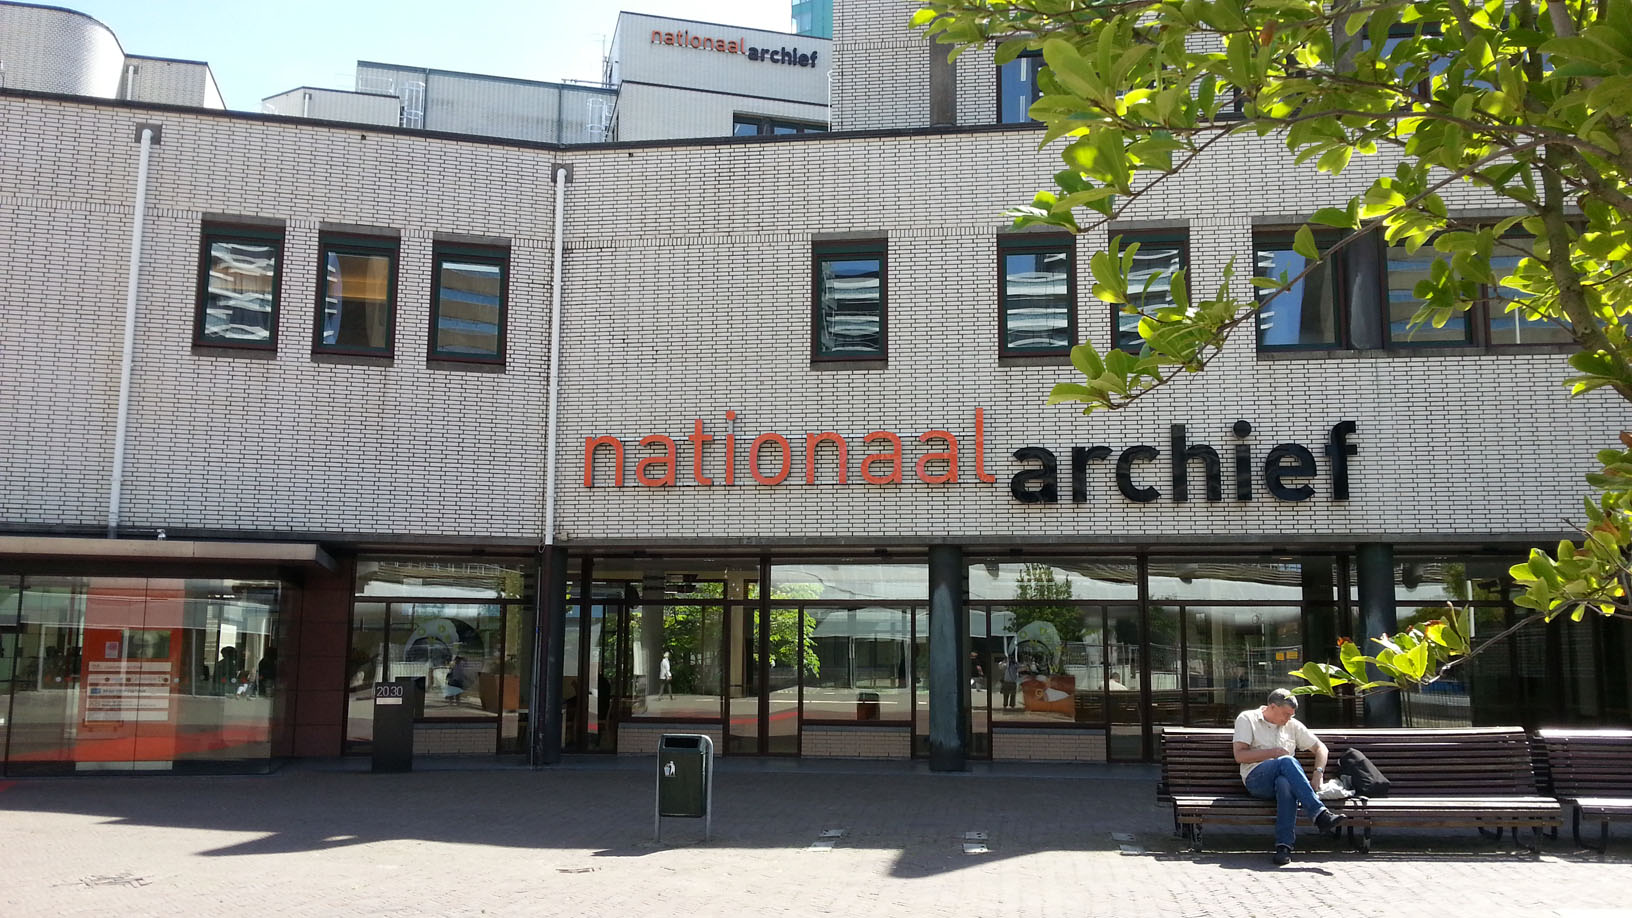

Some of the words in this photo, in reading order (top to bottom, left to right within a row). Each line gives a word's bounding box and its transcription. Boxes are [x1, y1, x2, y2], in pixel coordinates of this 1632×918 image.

[651, 29, 746, 55] nationaal
[748, 46, 818, 68] archief
[583, 407, 996, 488] nationaal
[1010, 420, 1358, 502] archief
